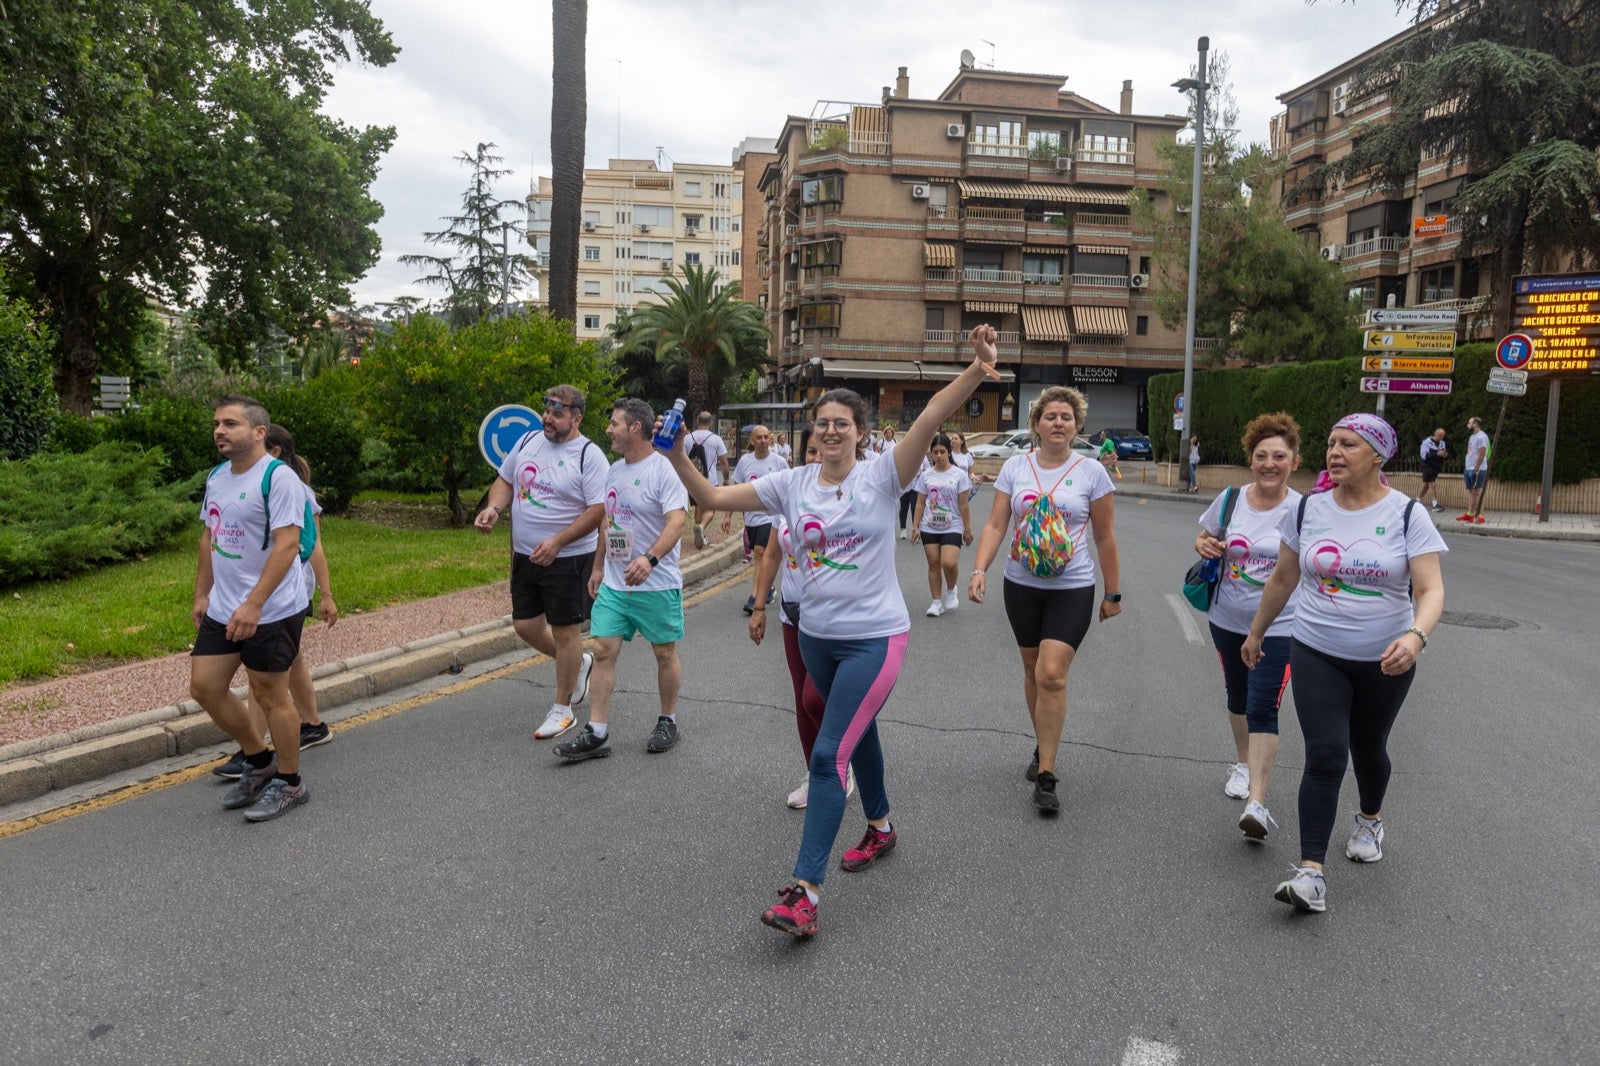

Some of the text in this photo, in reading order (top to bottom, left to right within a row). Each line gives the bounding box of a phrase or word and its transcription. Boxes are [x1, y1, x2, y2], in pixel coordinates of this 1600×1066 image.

[1582, 291, 1599, 301] CON
[1537, 303, 1589, 314] PINTURAS DE
[1522, 314, 1600, 326] JACINTO GUTIERREZ
[1539, 327, 1581, 336] "SALINAS"
[1572, 349, 1583, 358] EN
[1585, 348, 1596, 358] LA
[1419, 361, 1450, 369] Nevada
[1527, 360, 1588, 370] CASA DE ZAFRA
[1072, 366, 1118, 377] BLESSON
[1410, 382, 1449, 390] Alhambra
[610, 538, 626, 549] 3519
[826, 535, 864, 548] corazón
[1366, 559, 1380, 569] solo
[1338, 566, 1389, 578] corazón
